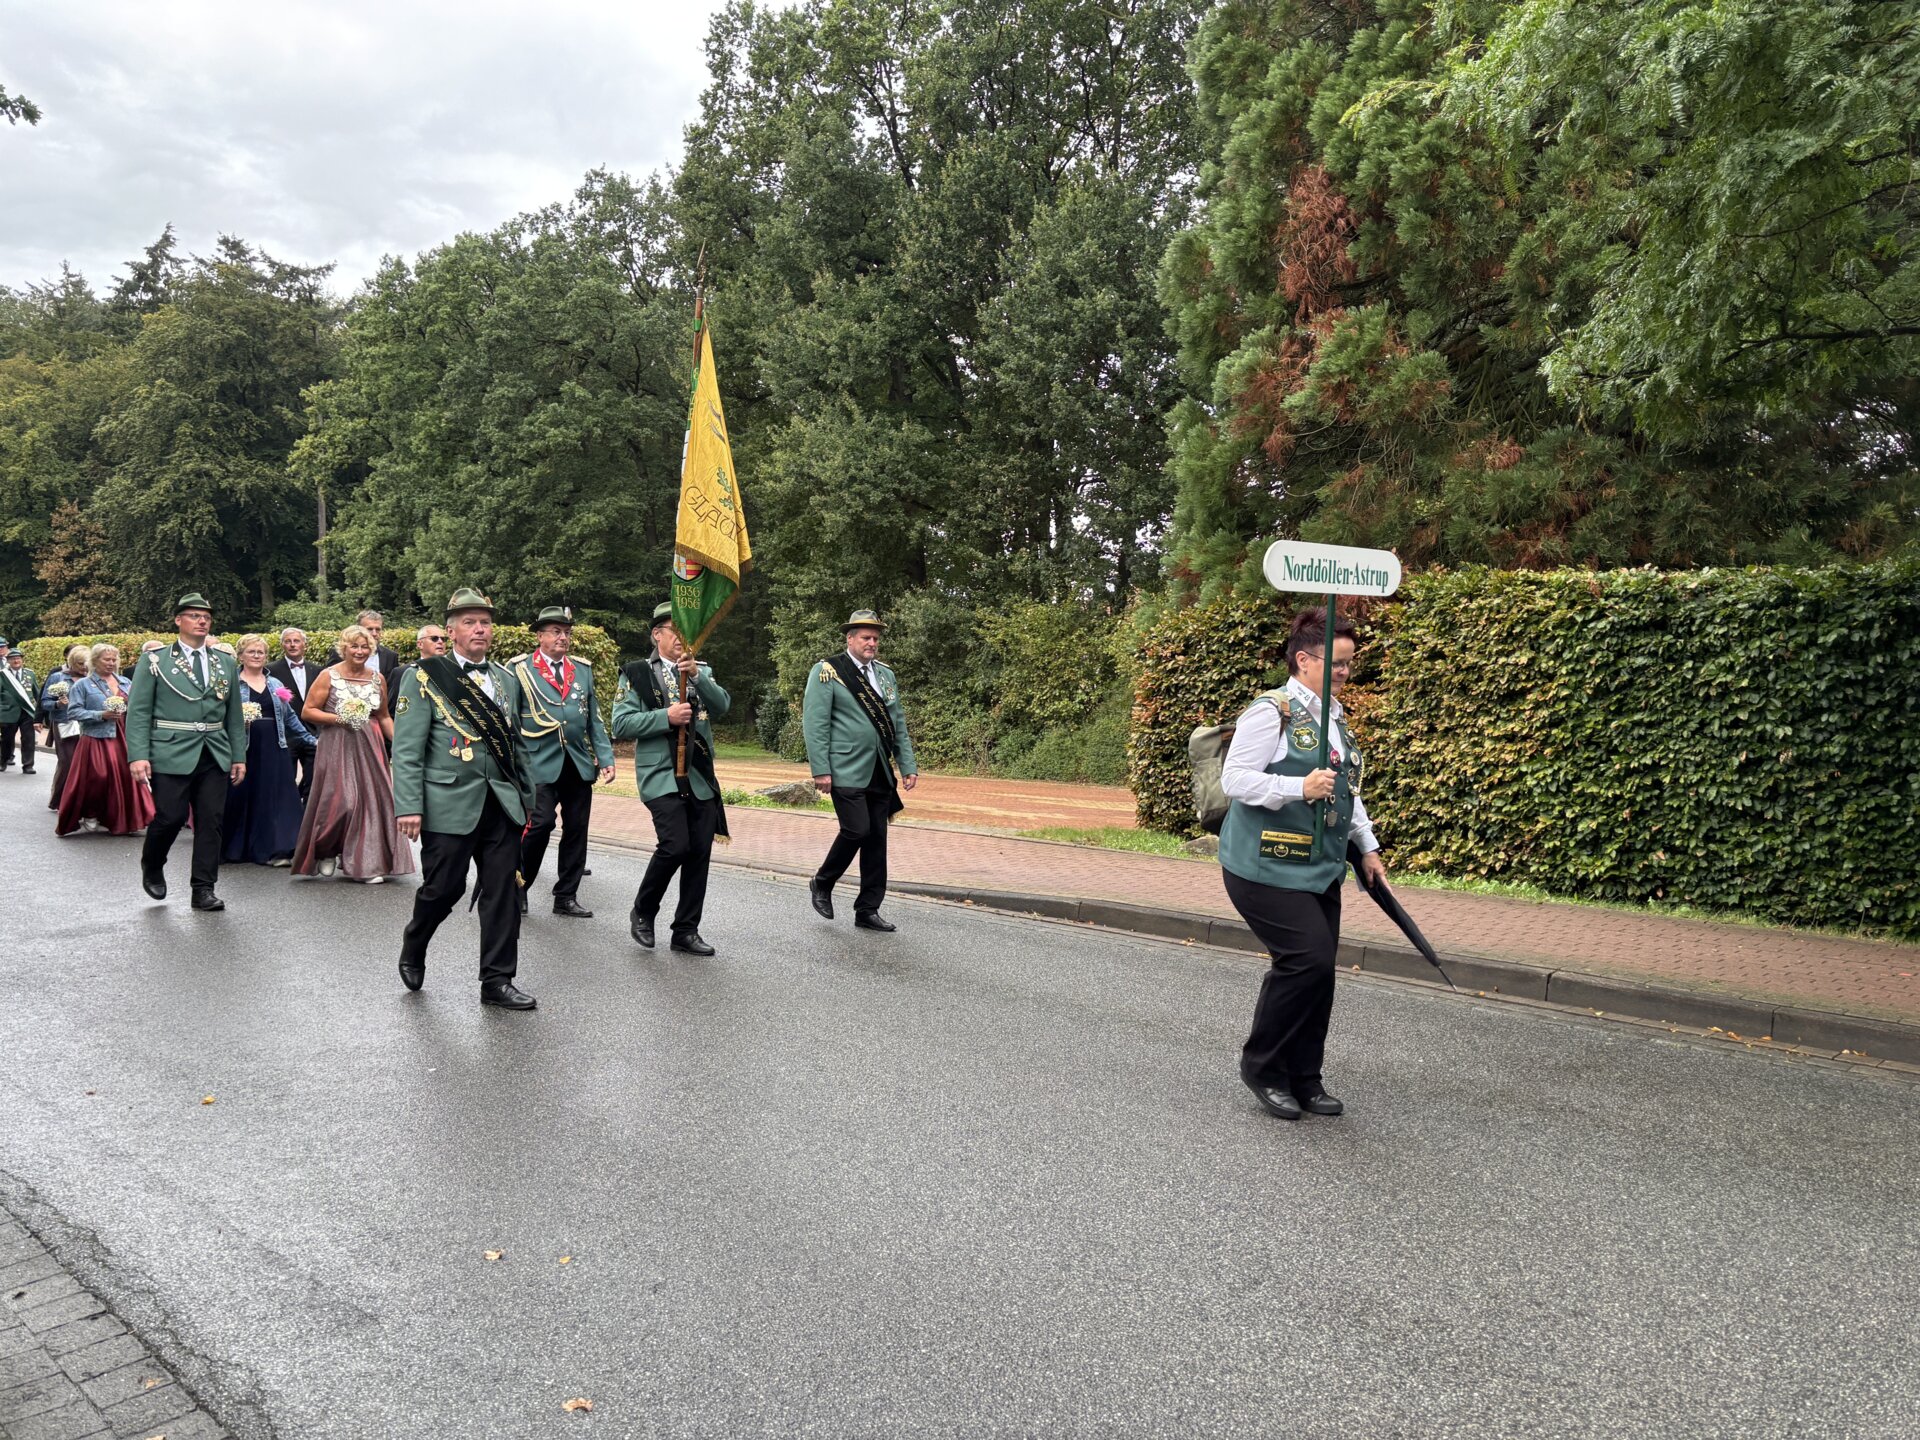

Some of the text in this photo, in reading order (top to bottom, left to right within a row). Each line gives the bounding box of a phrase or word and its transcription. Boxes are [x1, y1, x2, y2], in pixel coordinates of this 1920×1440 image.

[685, 486, 737, 542] GLAU
[674, 585, 700, 598] 1936
[675, 596, 700, 609] 1956
